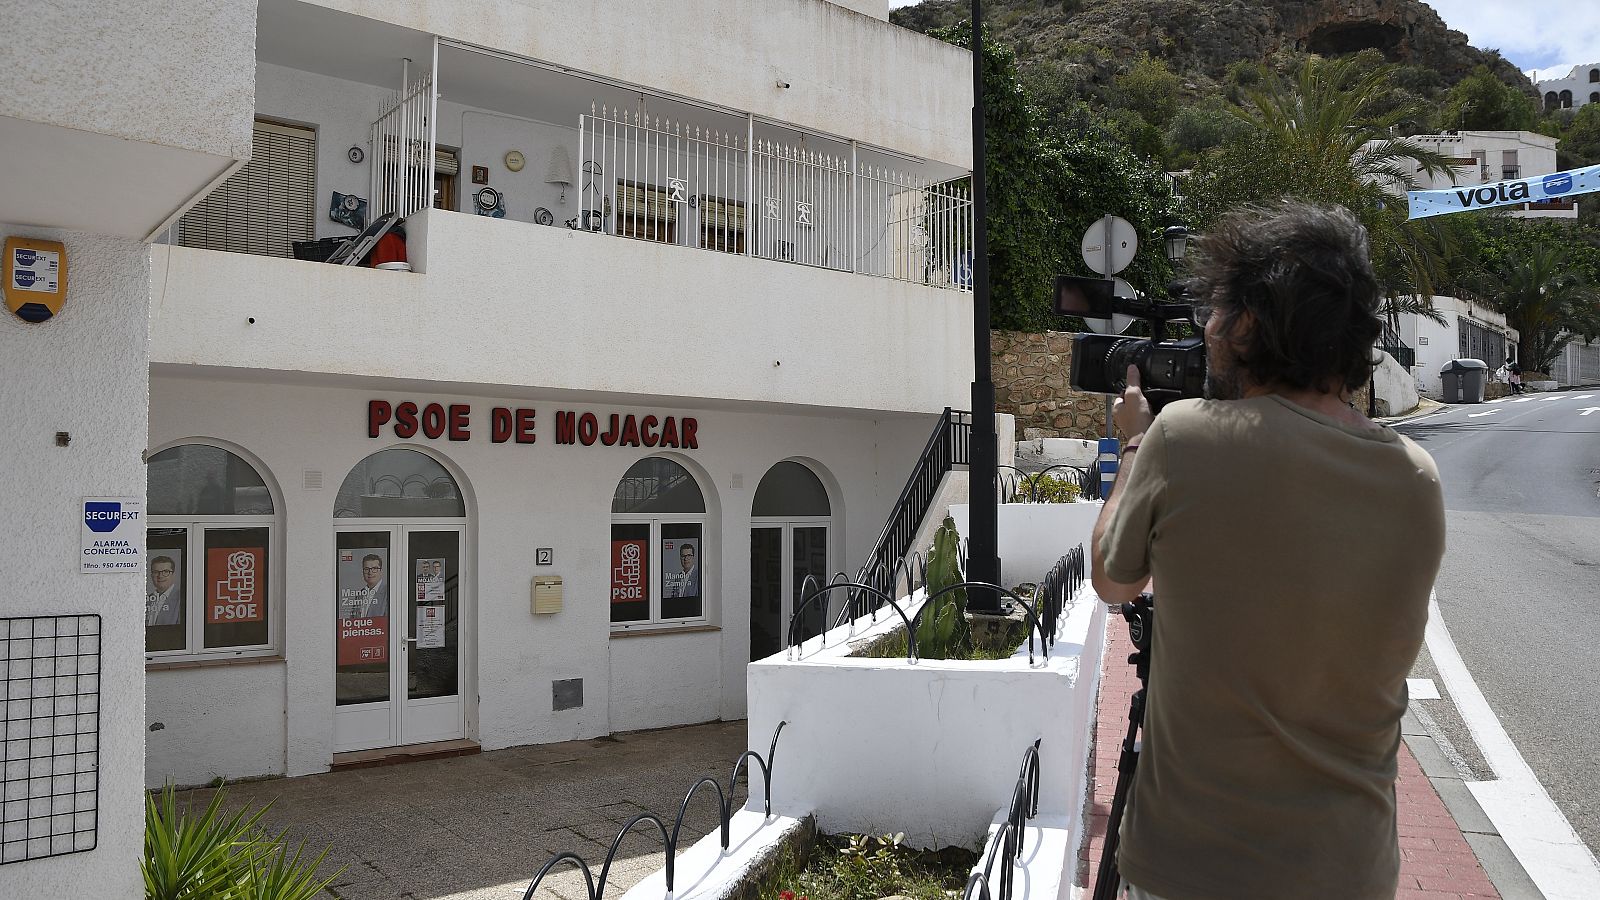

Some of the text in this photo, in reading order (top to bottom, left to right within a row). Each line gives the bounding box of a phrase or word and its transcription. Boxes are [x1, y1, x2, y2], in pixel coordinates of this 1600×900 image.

[1456, 181, 1530, 208] vota
[368, 400, 699, 449] PSOE DE MOJACAR
[85, 511, 139, 520] SECUREXT
[540, 551, 548, 562] 2
[341, 588, 376, 597] Manolo
[612, 587, 642, 600] PSOE
[341, 597, 378, 606] Zamora
[214, 603, 257, 620] PSOE
[342, 618, 373, 628] lo que
[342, 628, 385, 639] piensas.
